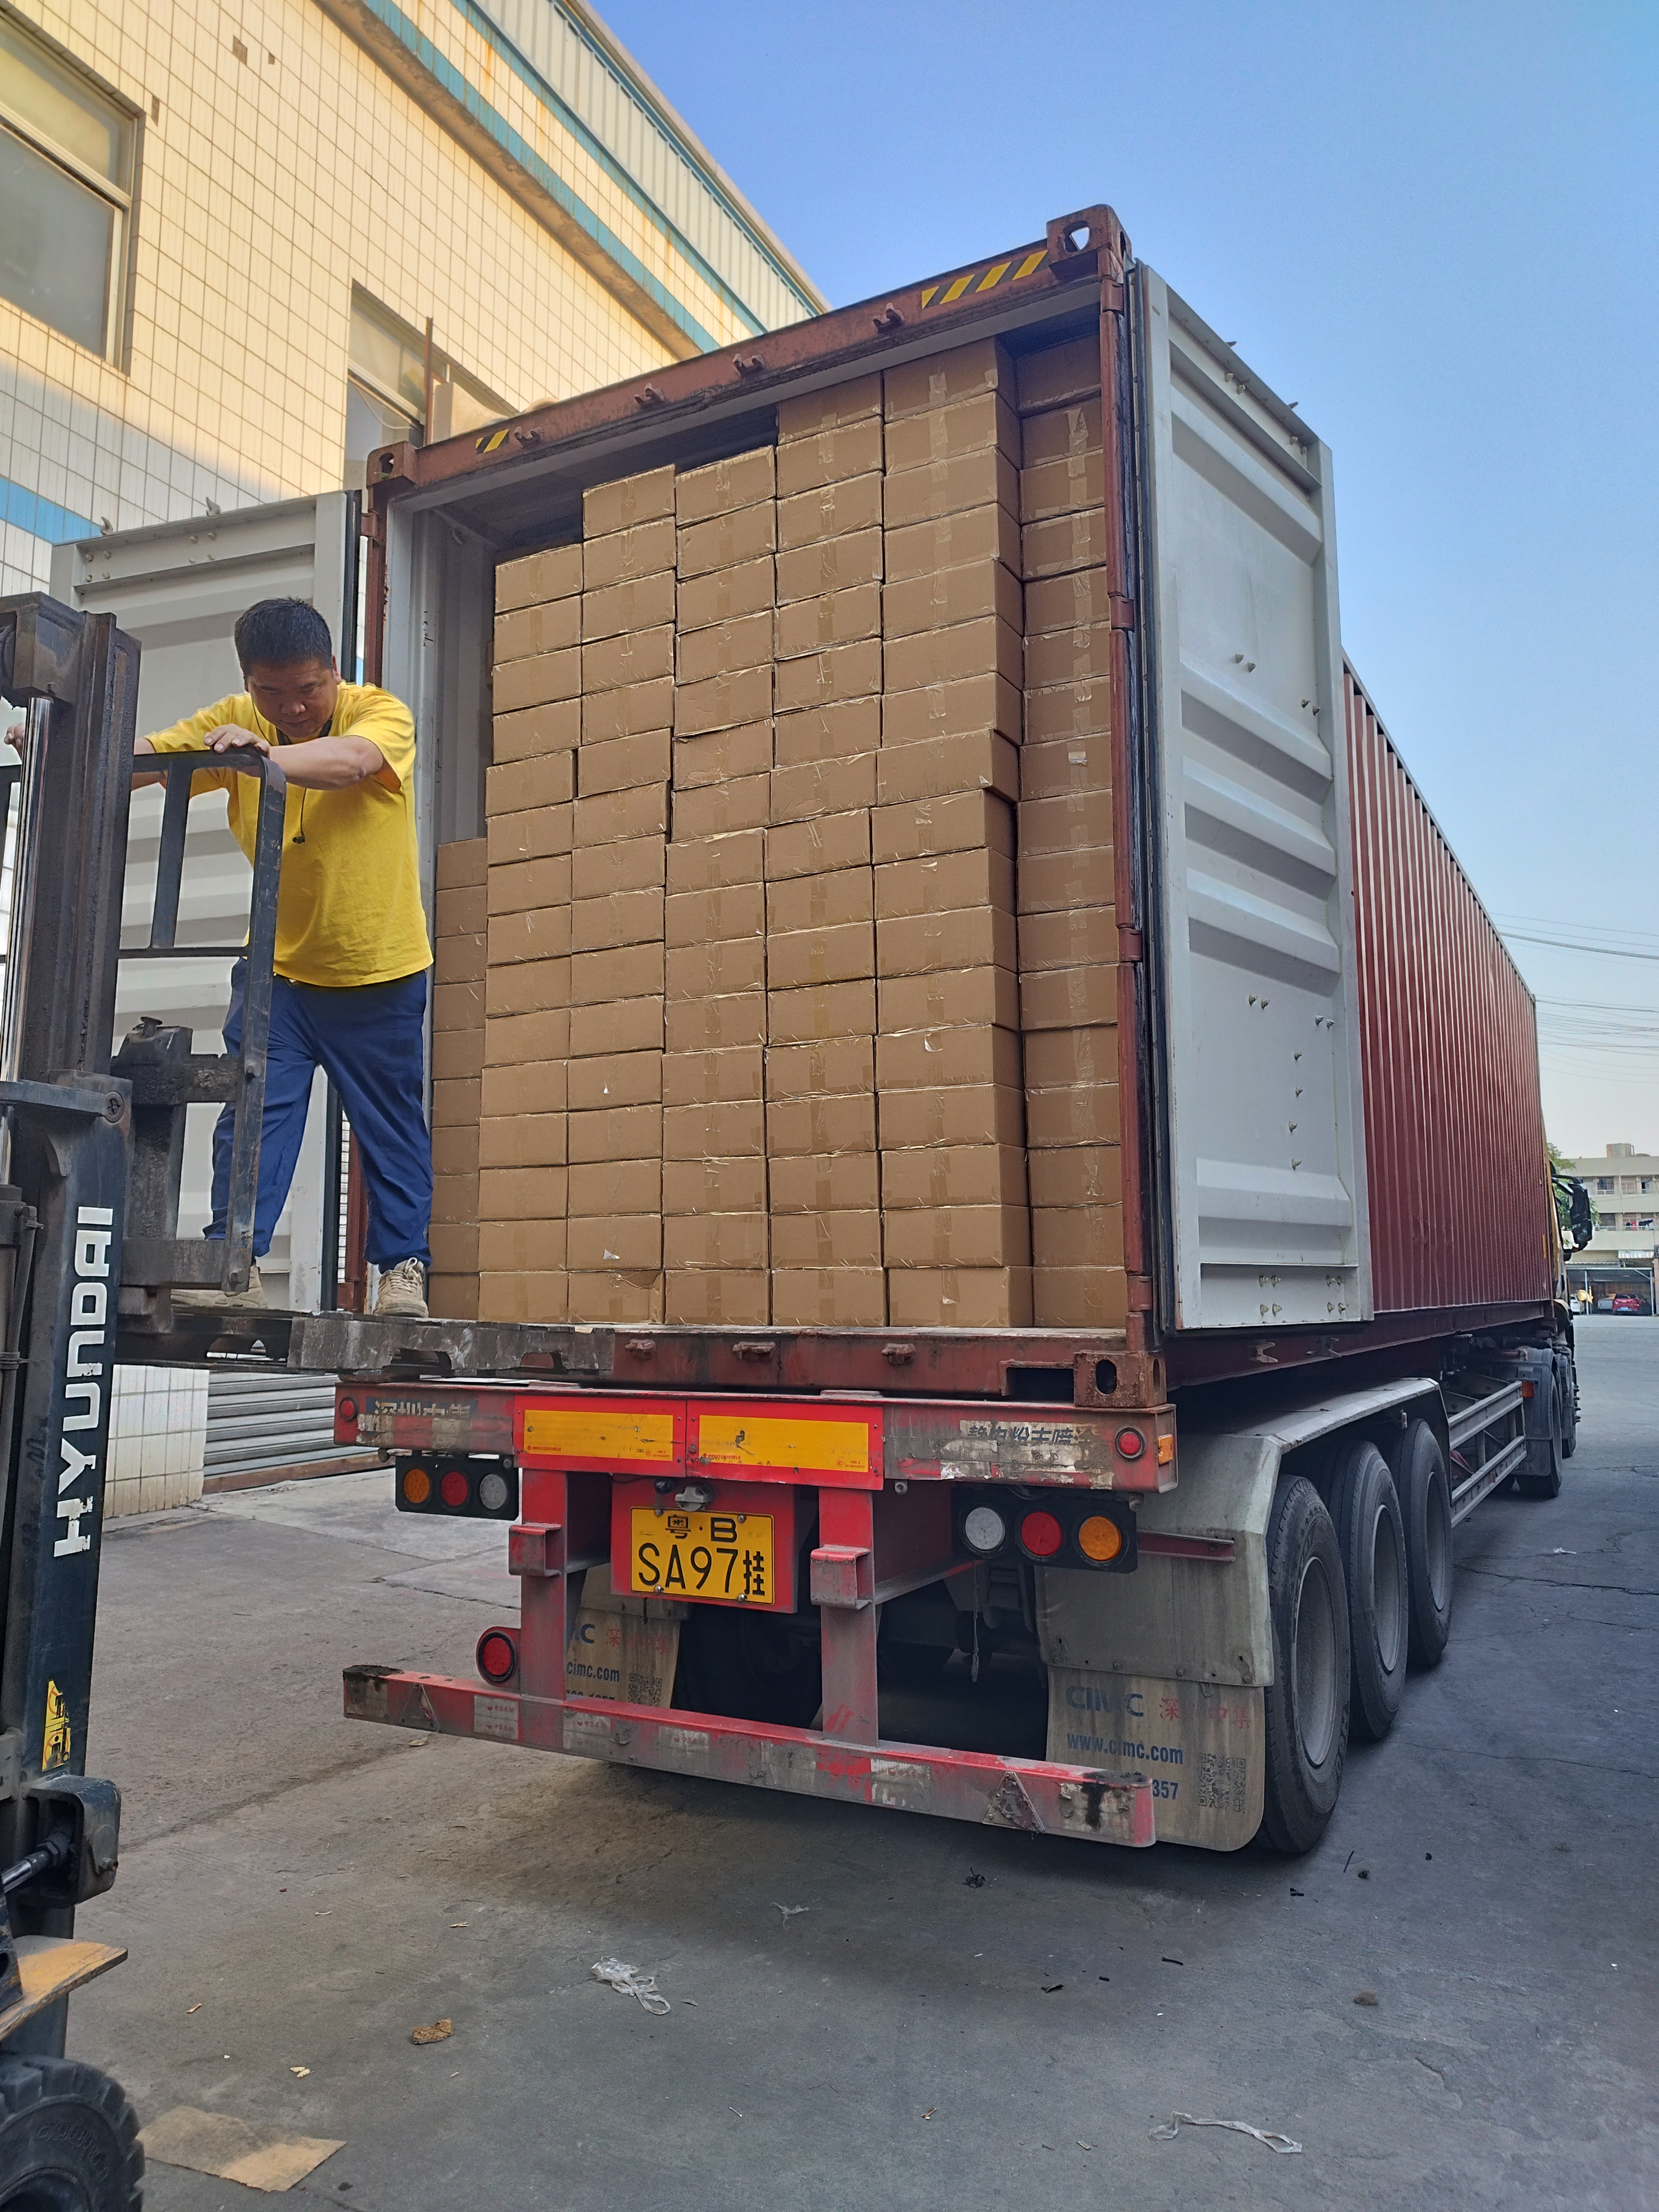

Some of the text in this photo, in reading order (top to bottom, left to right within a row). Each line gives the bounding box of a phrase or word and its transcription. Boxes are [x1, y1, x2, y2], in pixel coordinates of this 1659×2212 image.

[54, 1206, 114, 1558] HYUNDAI
[967, 1425, 1095, 1444] 静电粉末喷
[638, 1542, 765, 1595] SA97挂
[566, 1660, 620, 1682] cimc.com
[1067, 1733, 1184, 1765] www.cimc.com
